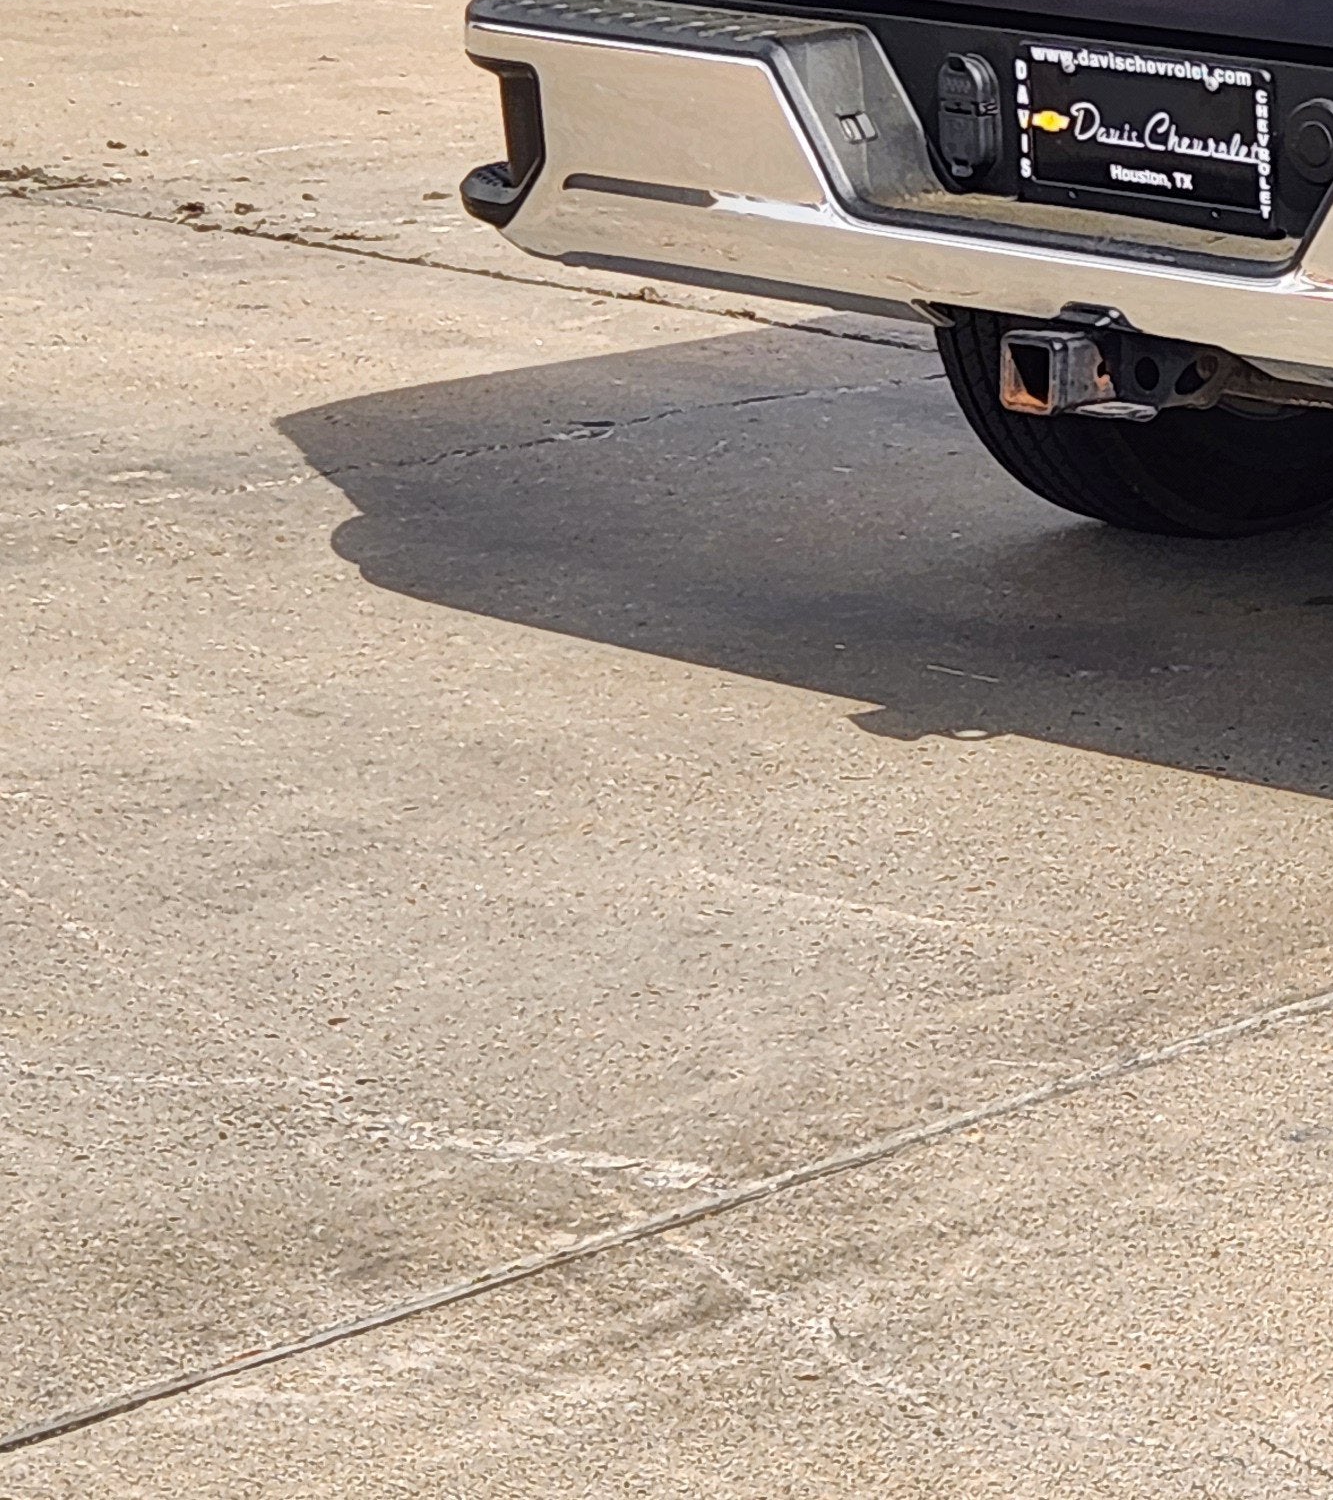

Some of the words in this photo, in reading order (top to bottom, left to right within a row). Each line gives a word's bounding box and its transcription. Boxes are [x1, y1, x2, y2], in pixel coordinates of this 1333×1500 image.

[1015, 59, 1032, 179] DAVIS
[1070, 101, 1145, 148] Davis
[1255, 89, 1272, 219] CHEVROLET
[1109, 164, 1172, 189] Houston,
[1172, 171, 1193, 191] TX
